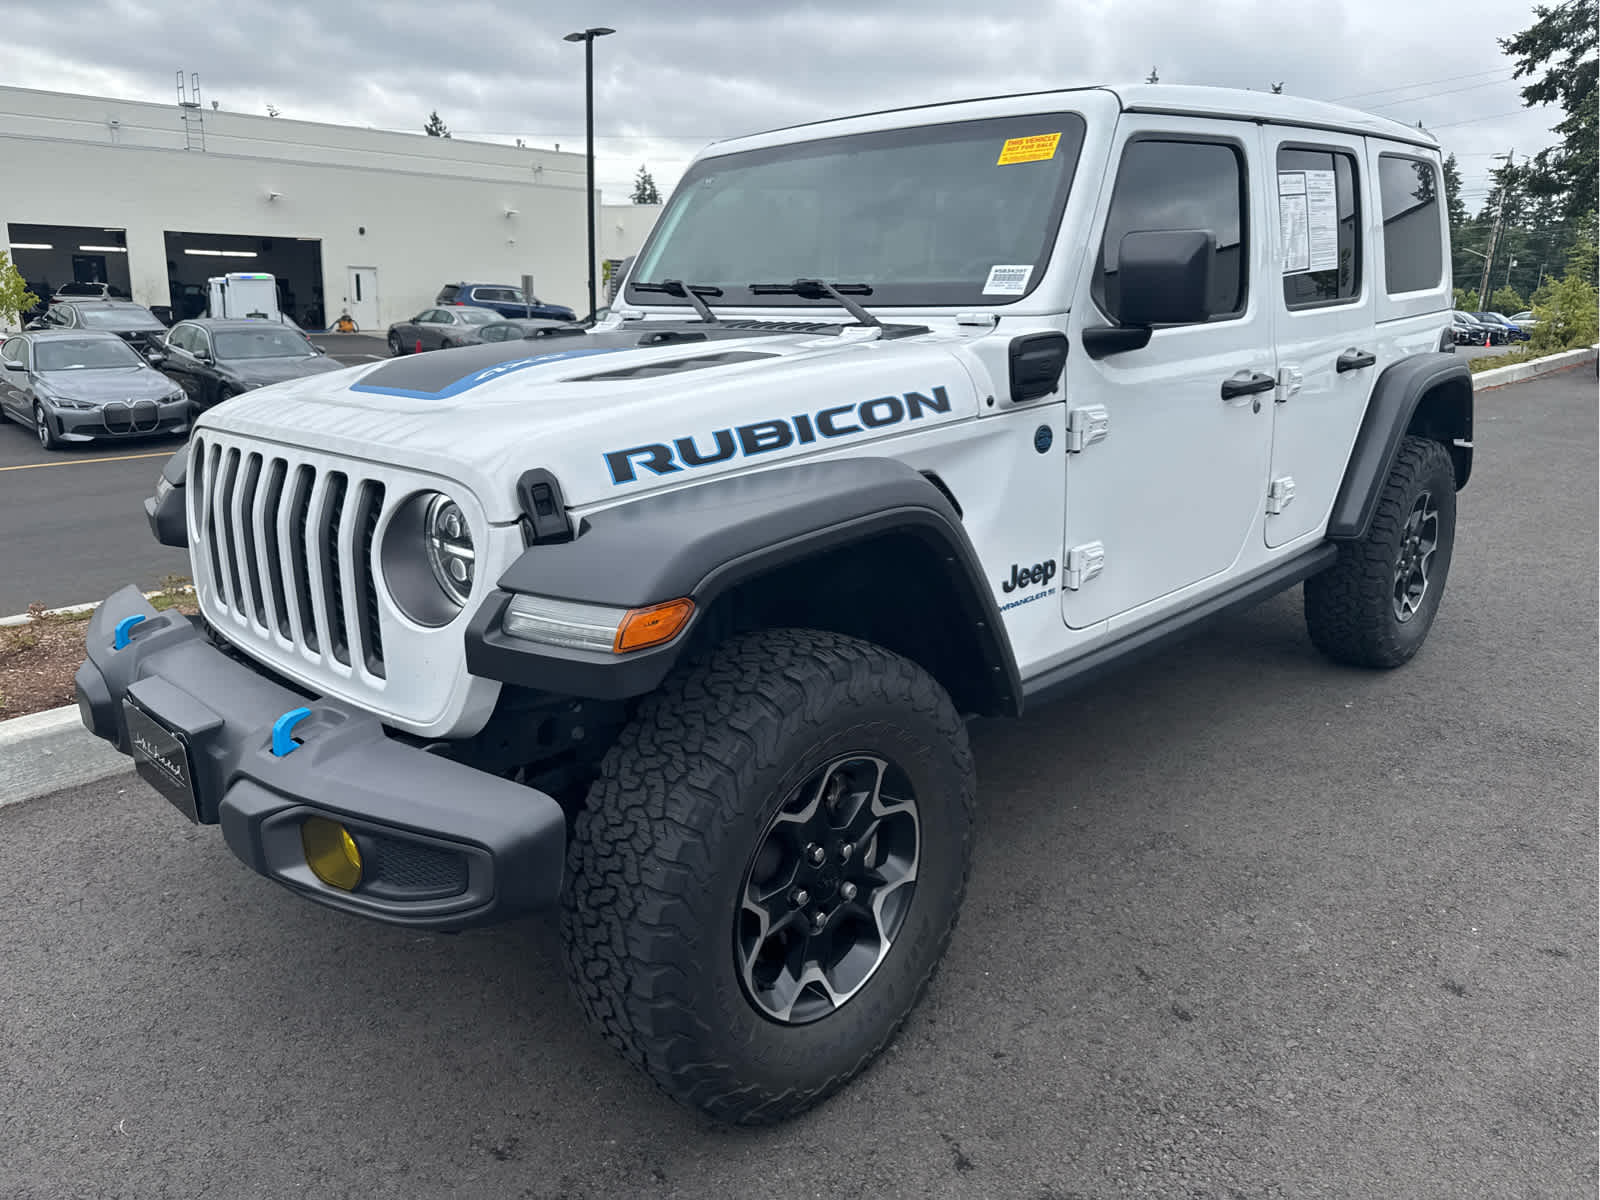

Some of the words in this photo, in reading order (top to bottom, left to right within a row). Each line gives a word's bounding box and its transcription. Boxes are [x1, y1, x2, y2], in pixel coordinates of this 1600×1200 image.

[1026, 135, 1057, 144] VEHICLE
[603, 386, 952, 486] RUBICON
[1002, 559, 1056, 593] Jeep
